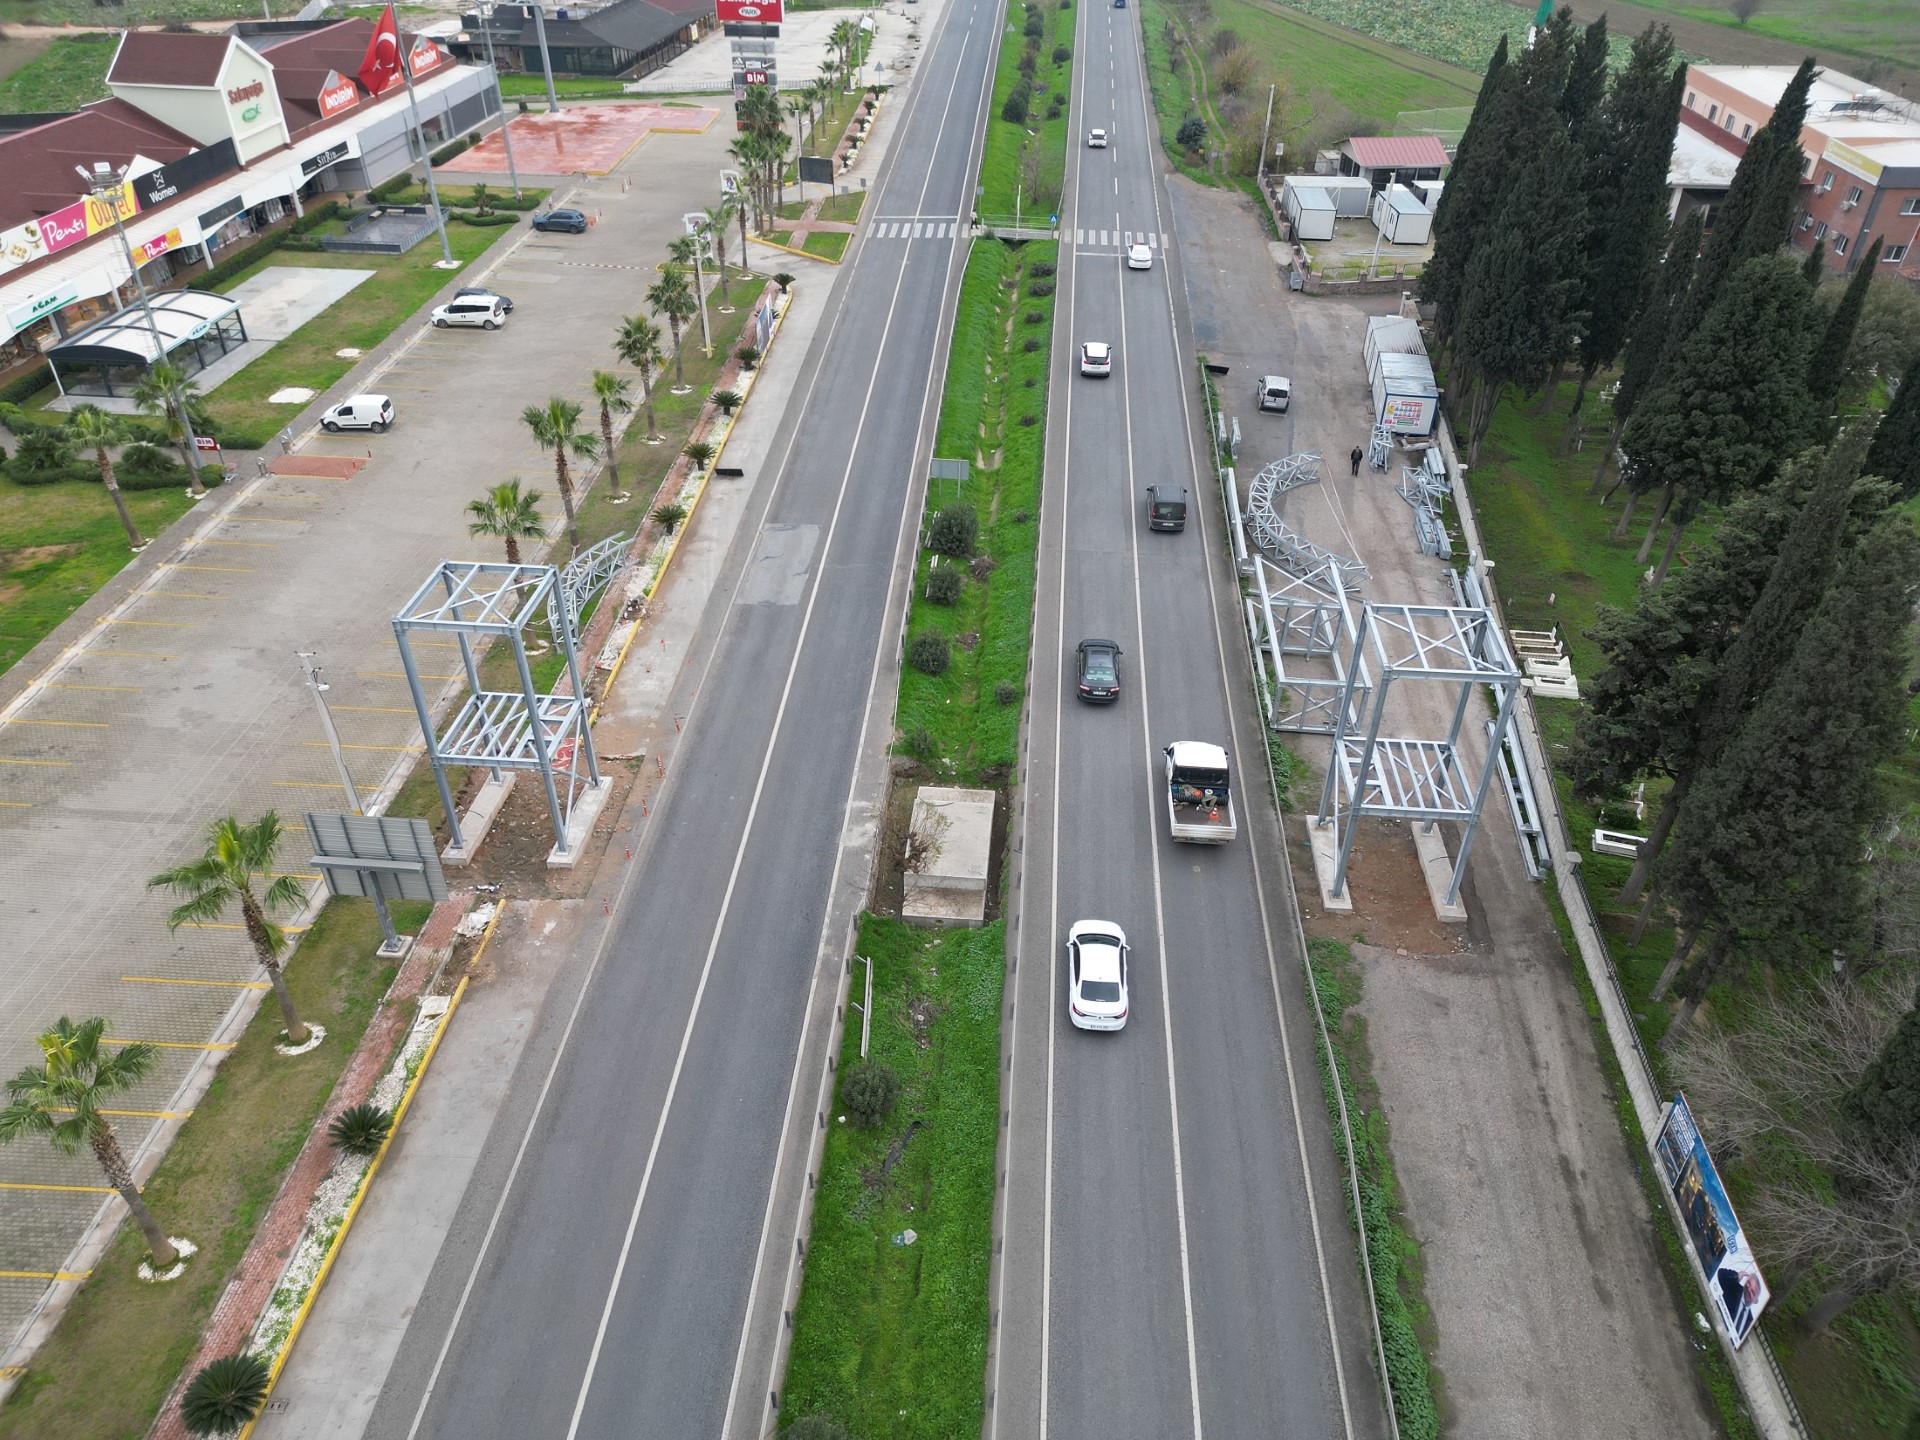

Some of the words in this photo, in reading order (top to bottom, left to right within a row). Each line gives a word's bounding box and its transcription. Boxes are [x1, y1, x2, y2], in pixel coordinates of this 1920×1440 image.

[746, 72, 765, 83] BİM
[324, 86, 355, 110] İNDİRİM
[149, 185, 178, 203] Women
[42, 218, 85, 246] Penti
[32, 295, 57, 313] AĞAM
